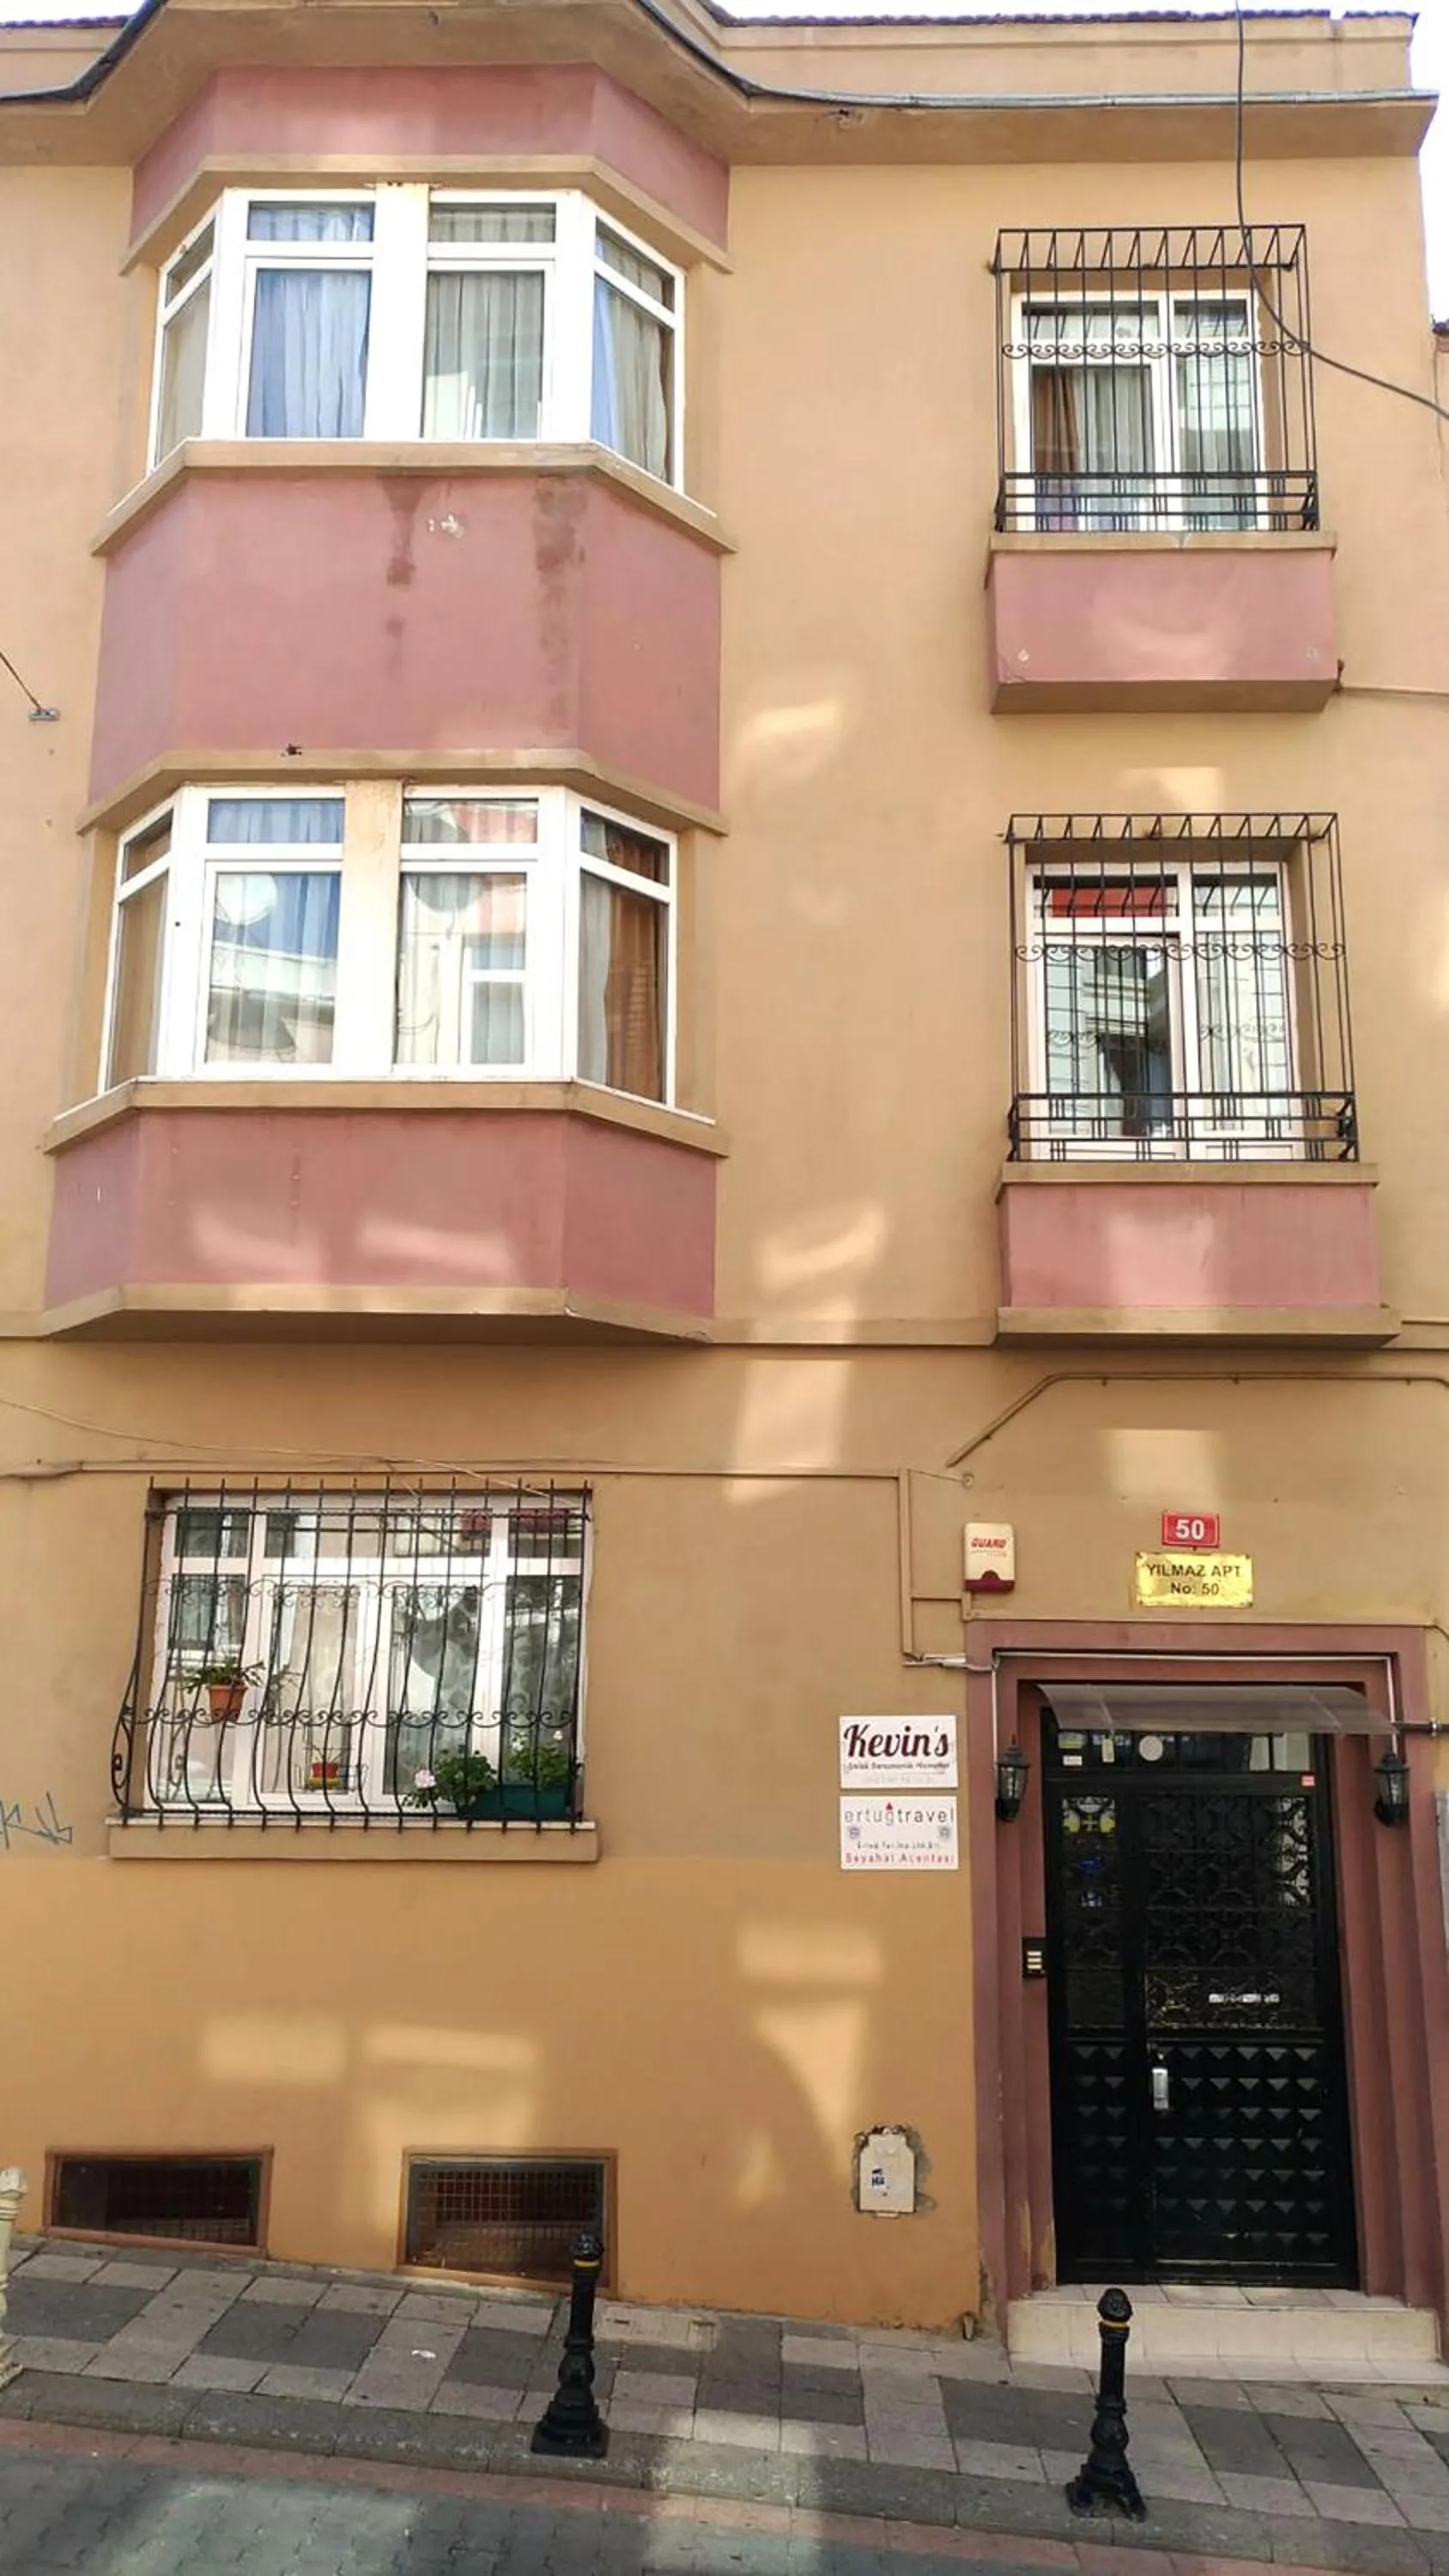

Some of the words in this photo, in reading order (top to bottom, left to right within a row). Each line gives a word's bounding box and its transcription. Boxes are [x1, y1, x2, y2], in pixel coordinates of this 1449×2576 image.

[1175, 1519, 1204, 1540] 50
[1147, 1564, 1205, 1577] YILMAZ
[1211, 1565, 1241, 1577] APT
[1202, 1583, 1220, 1595] 50
[844, 1723, 949, 1758] Kevin's
